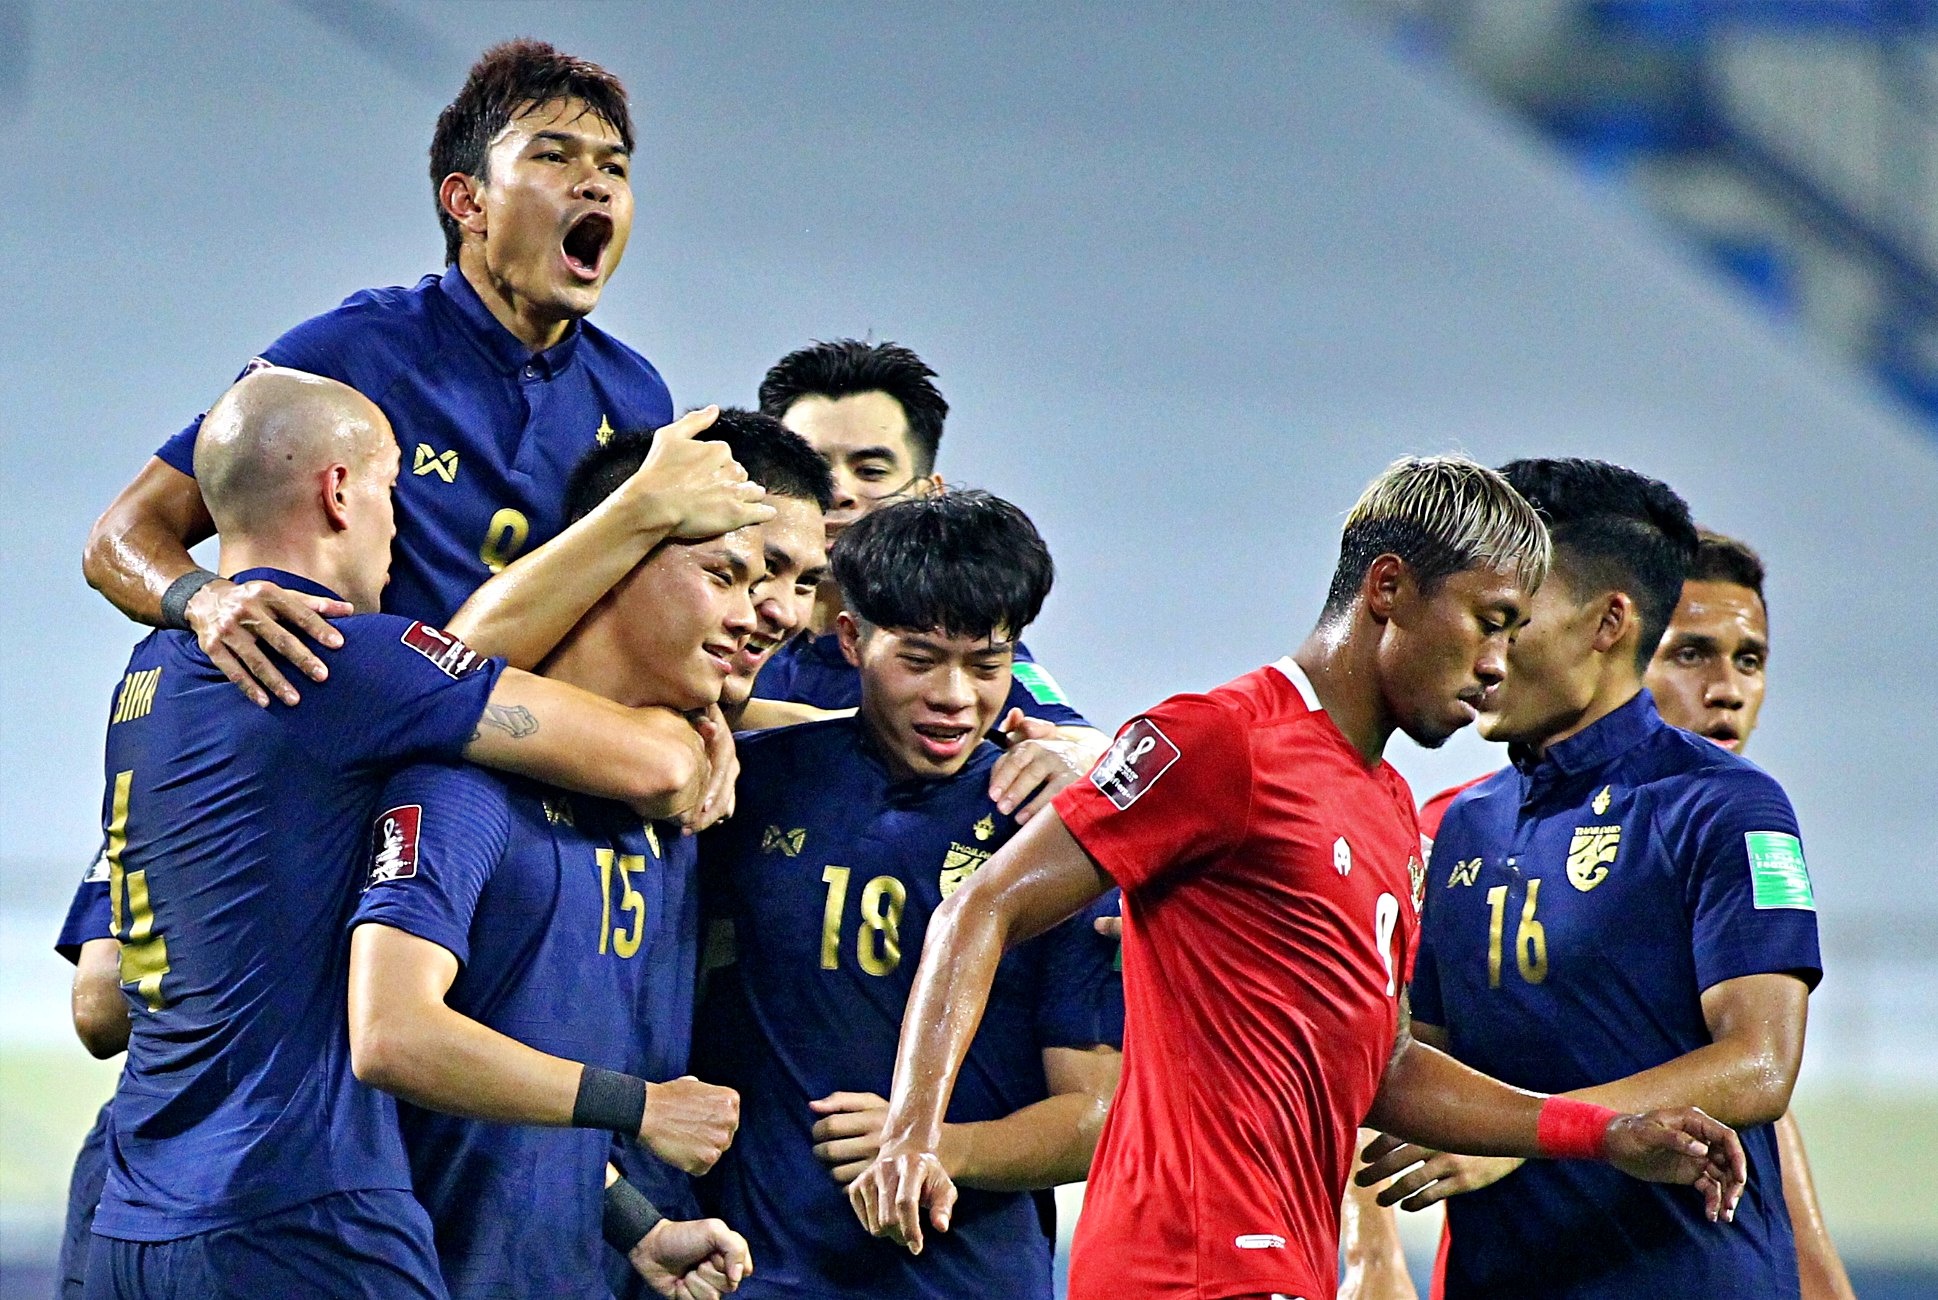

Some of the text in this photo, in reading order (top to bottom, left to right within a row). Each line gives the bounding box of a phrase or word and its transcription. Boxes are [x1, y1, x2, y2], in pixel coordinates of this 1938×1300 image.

[106, 769, 171, 1013] 4
[594, 847, 646, 959] 15
[820, 864, 907, 977] 18
[1375, 891, 1399, 997] 9
[1486, 877, 1548, 990] 16
